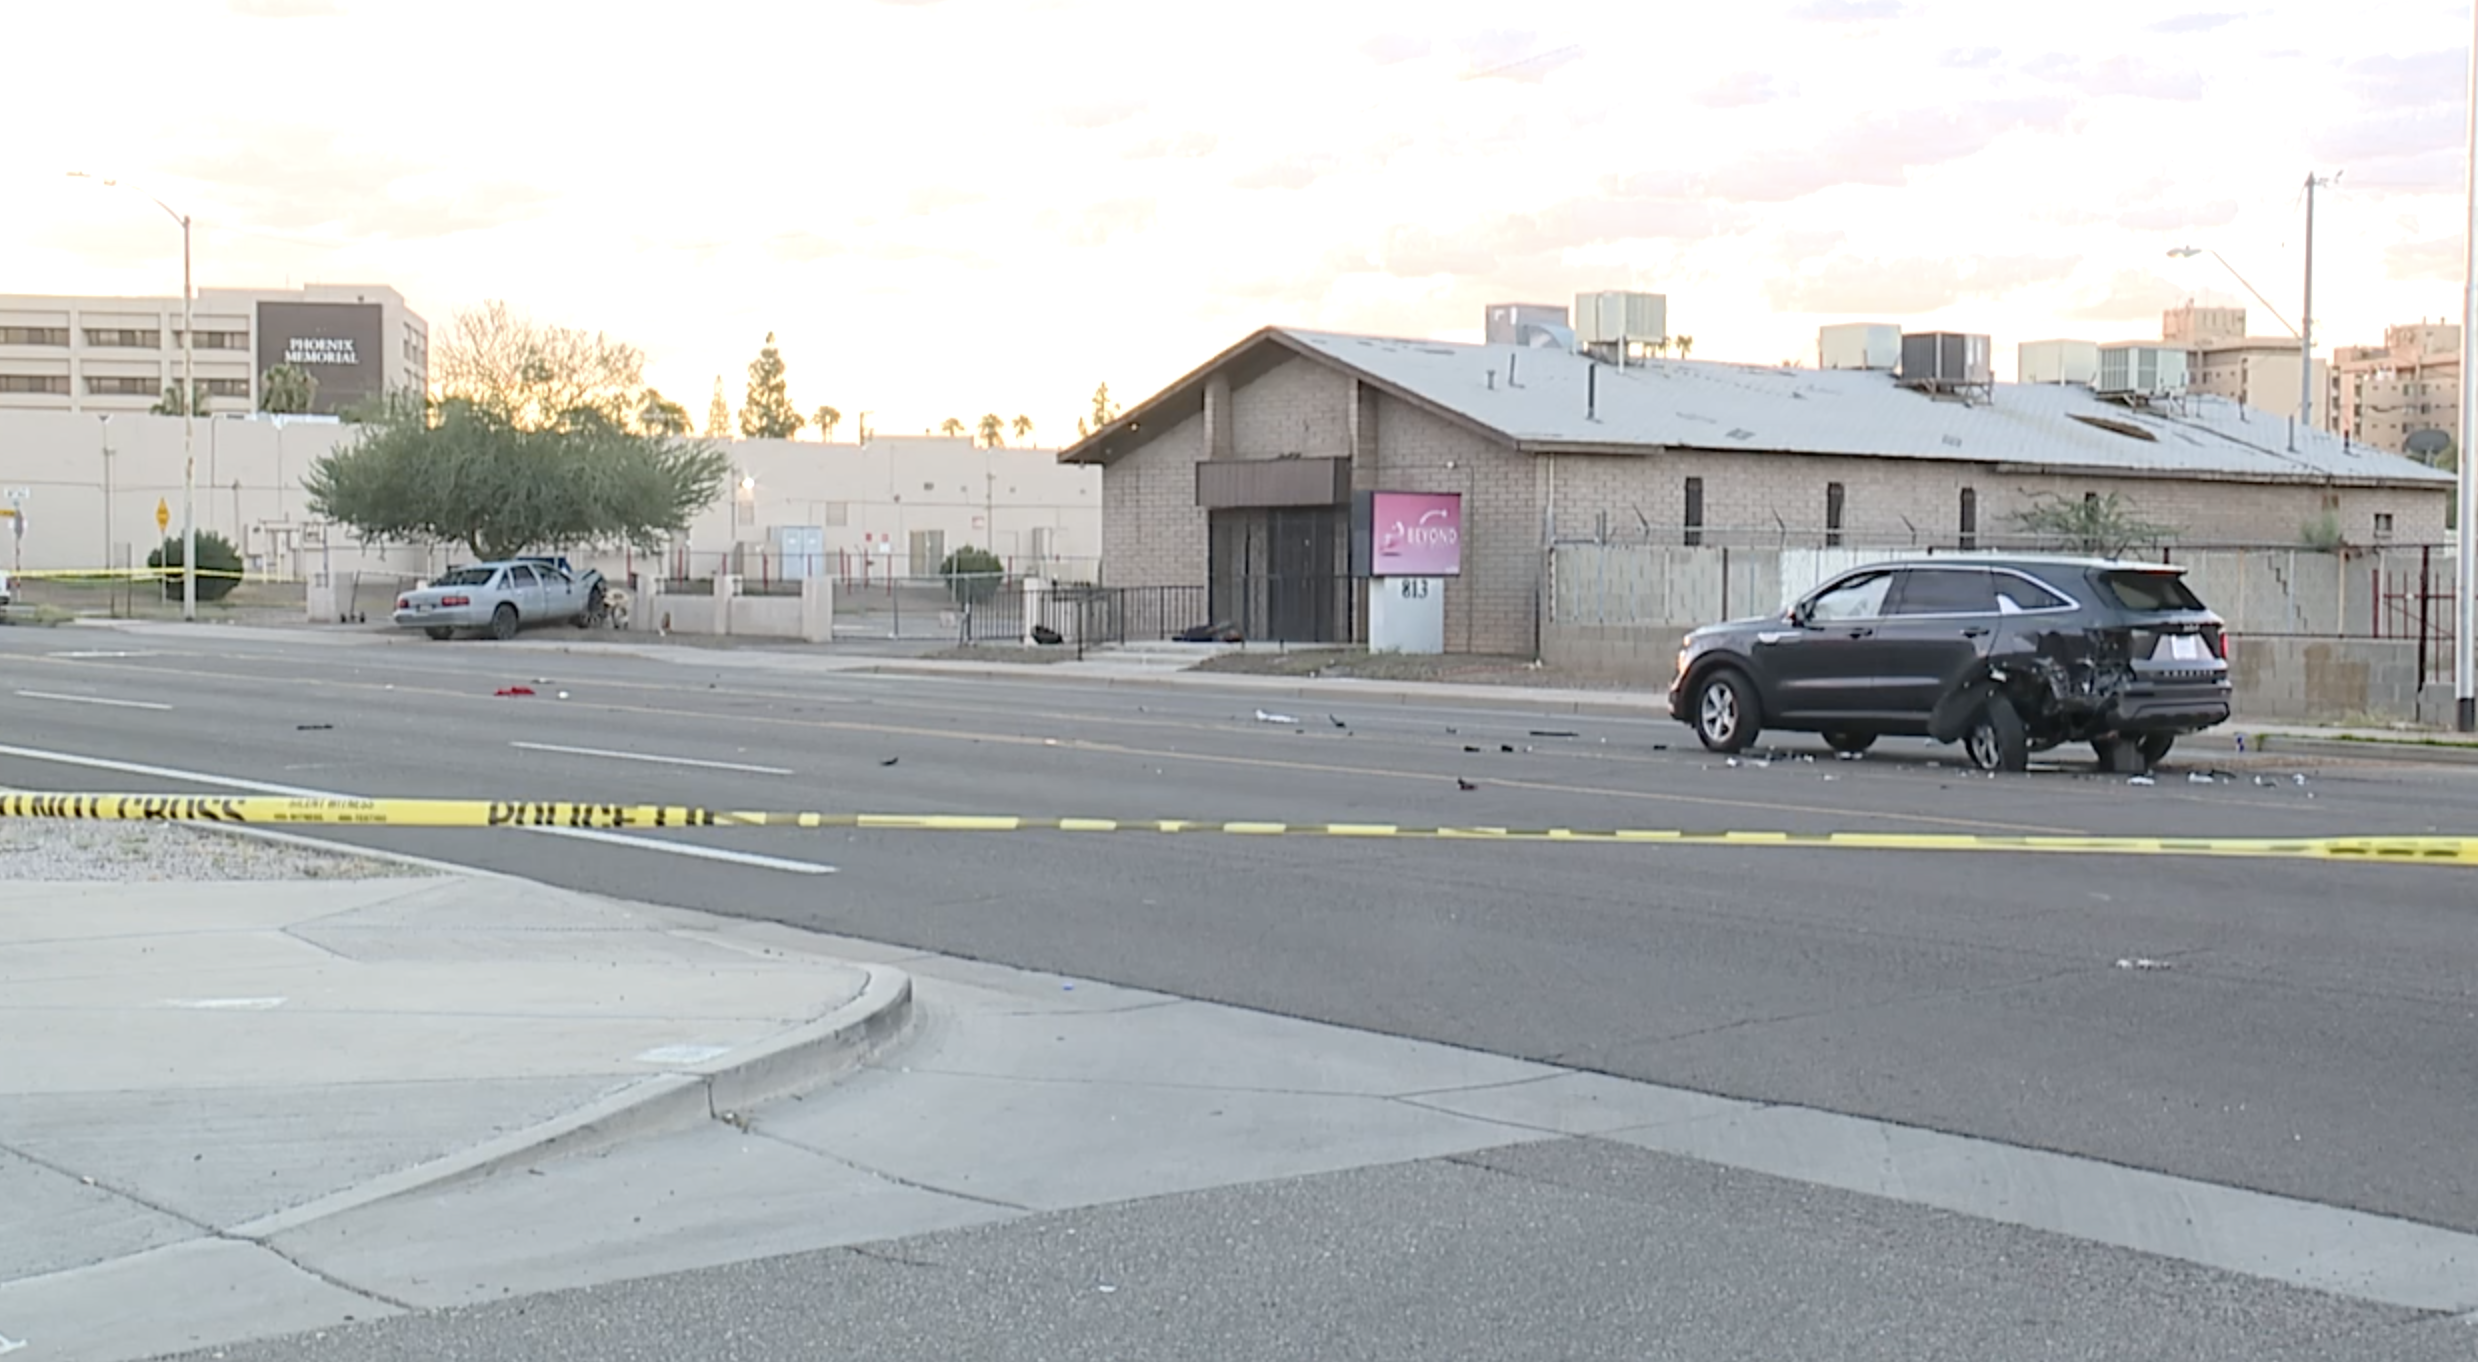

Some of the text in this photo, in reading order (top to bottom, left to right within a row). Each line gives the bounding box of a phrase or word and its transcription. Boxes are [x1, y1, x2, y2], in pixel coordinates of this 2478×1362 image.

[290, 338, 353, 352] PHOENIX
[285, 351, 358, 364] MEMORIAL
[1407, 528, 1458, 545] BEYOND
[1402, 579, 1429, 600] 813
[118, 797, 248, 823] CROSS
[488, 802, 636, 827] POLICE
